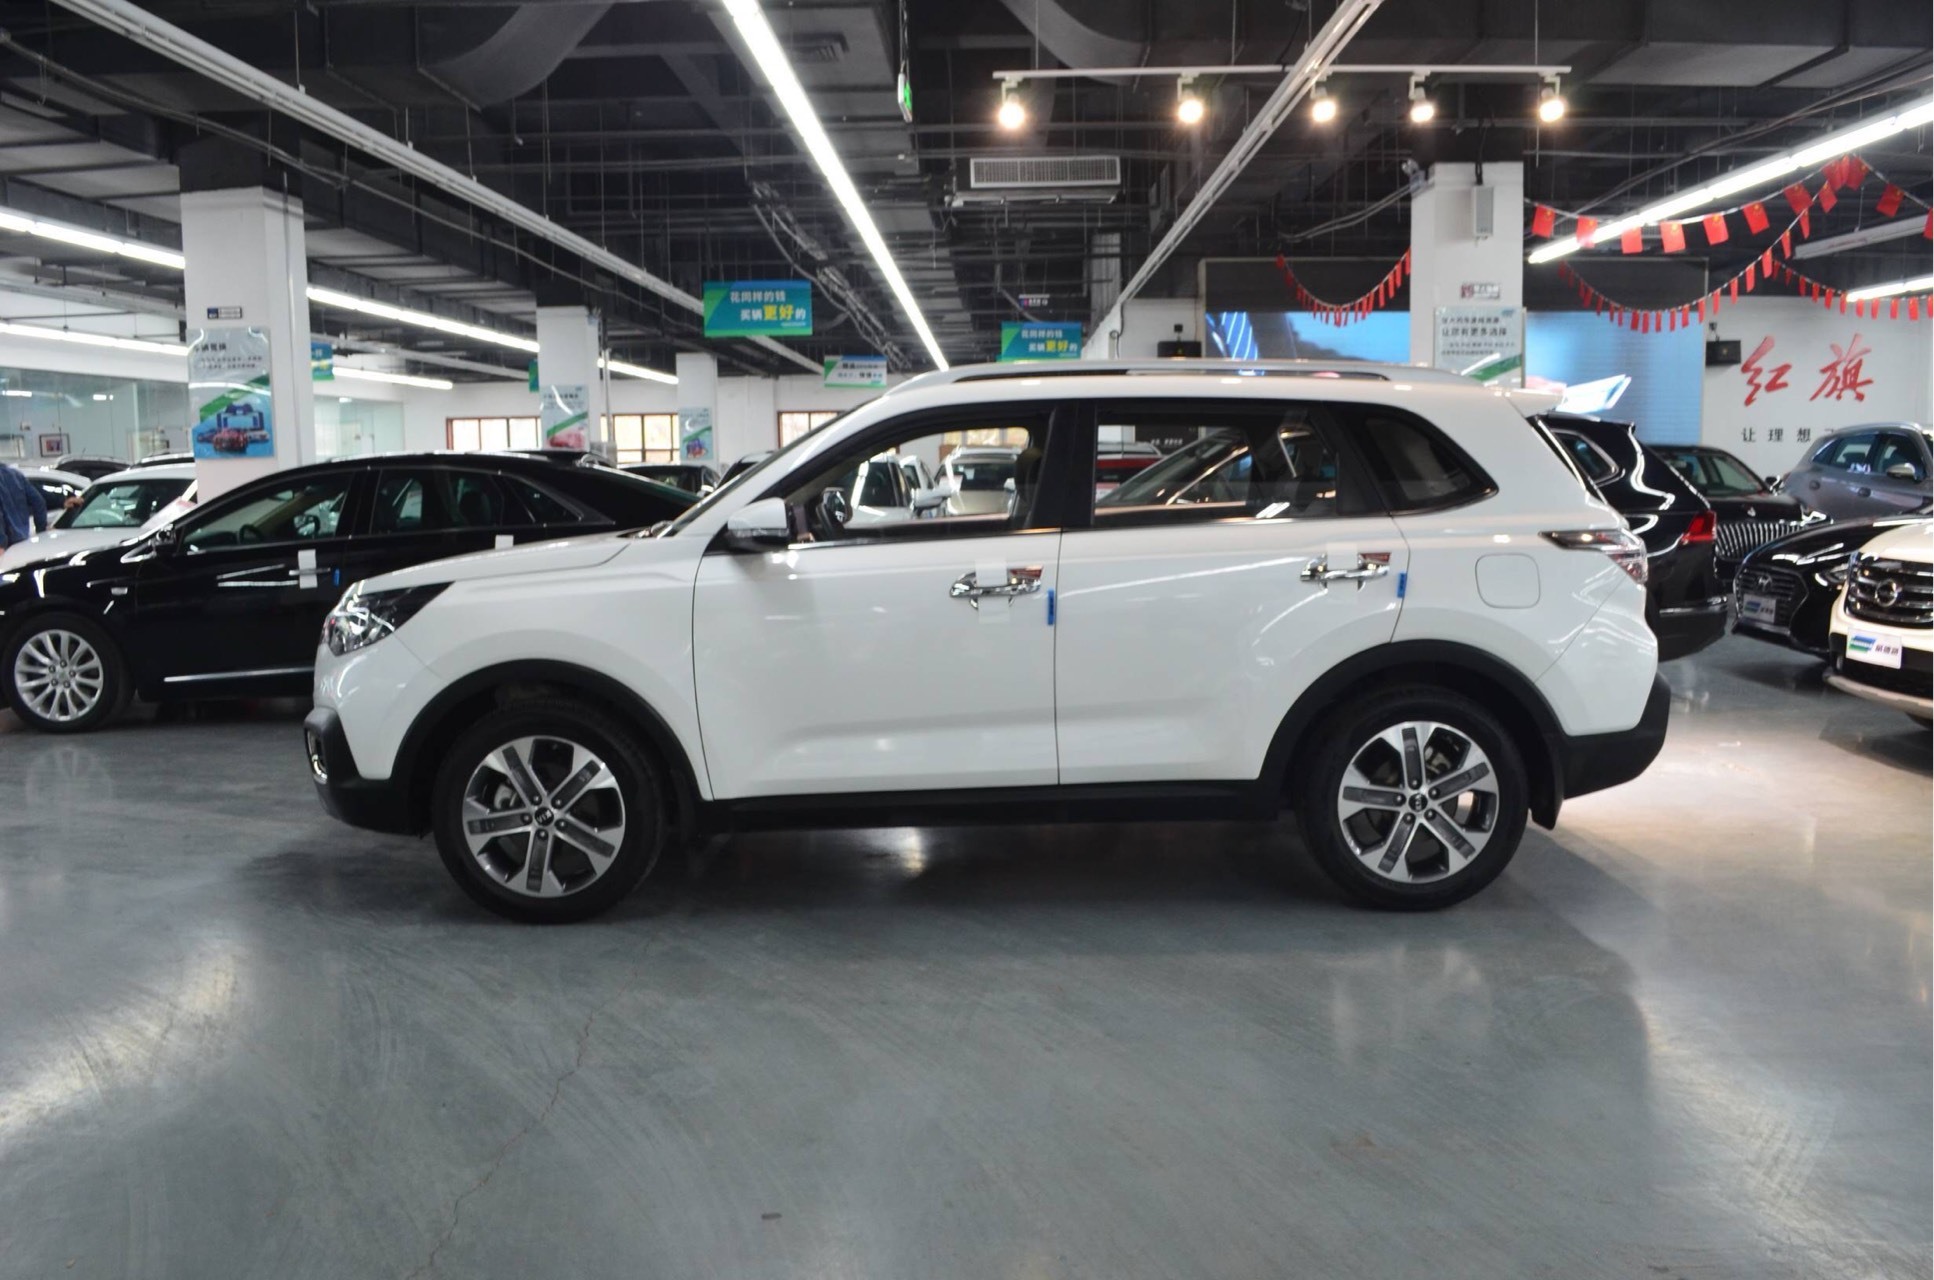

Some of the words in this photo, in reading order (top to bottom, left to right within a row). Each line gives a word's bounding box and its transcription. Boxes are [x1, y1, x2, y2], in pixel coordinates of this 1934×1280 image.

[730, 289, 786, 303] 花同样的钱
[741, 304, 807, 321] 买辆更好的
[1741, 333, 1874, 407] 红旗
[1741, 427, 1836, 443] 让理想
